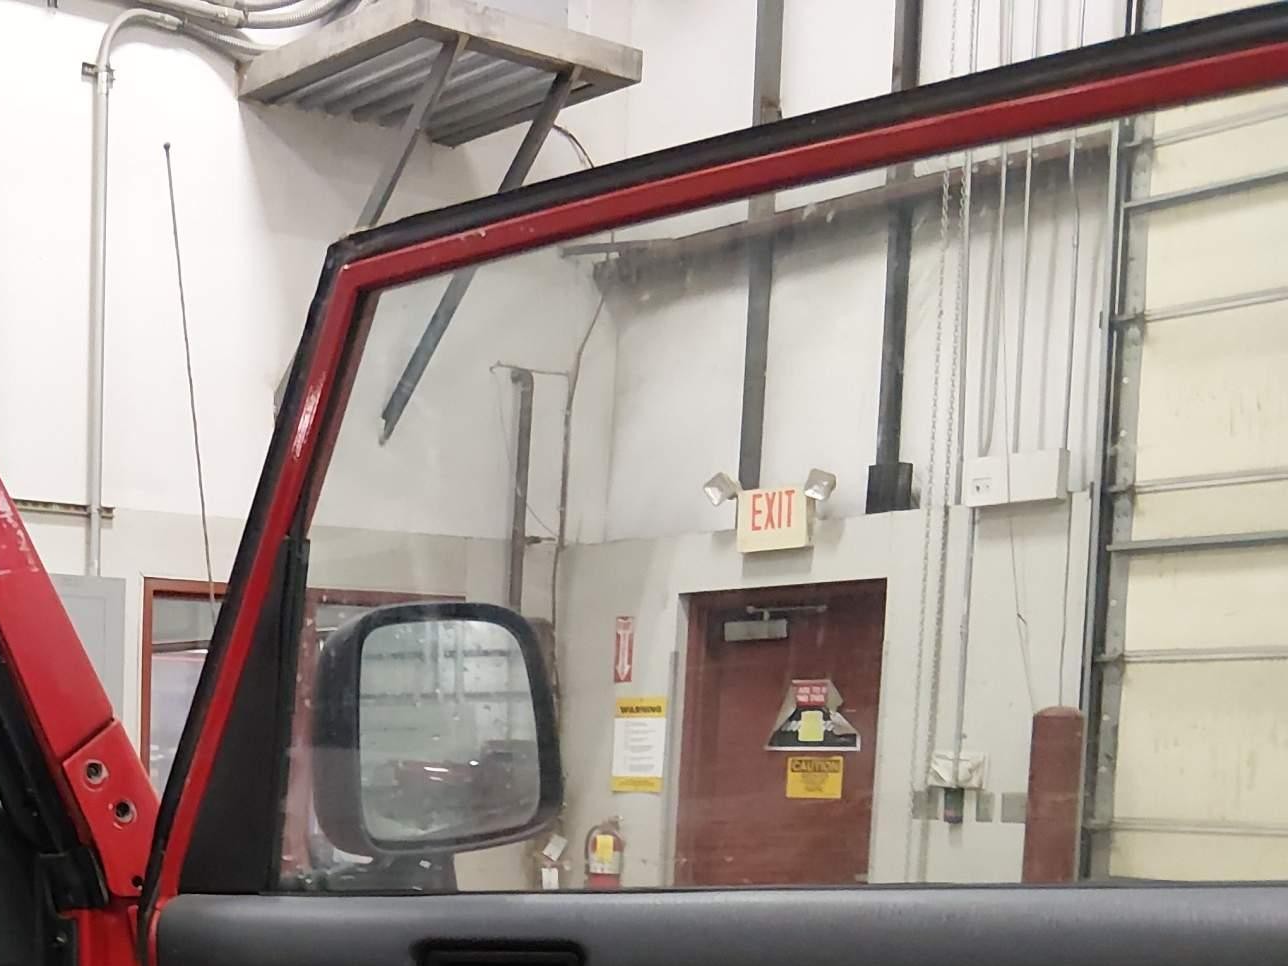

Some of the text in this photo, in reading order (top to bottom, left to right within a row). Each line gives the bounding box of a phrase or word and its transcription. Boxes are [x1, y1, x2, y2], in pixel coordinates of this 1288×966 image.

[752, 489, 795, 531] EXIT
[619, 705, 663, 715] WARNING
[792, 760, 841, 773] CAUTION
